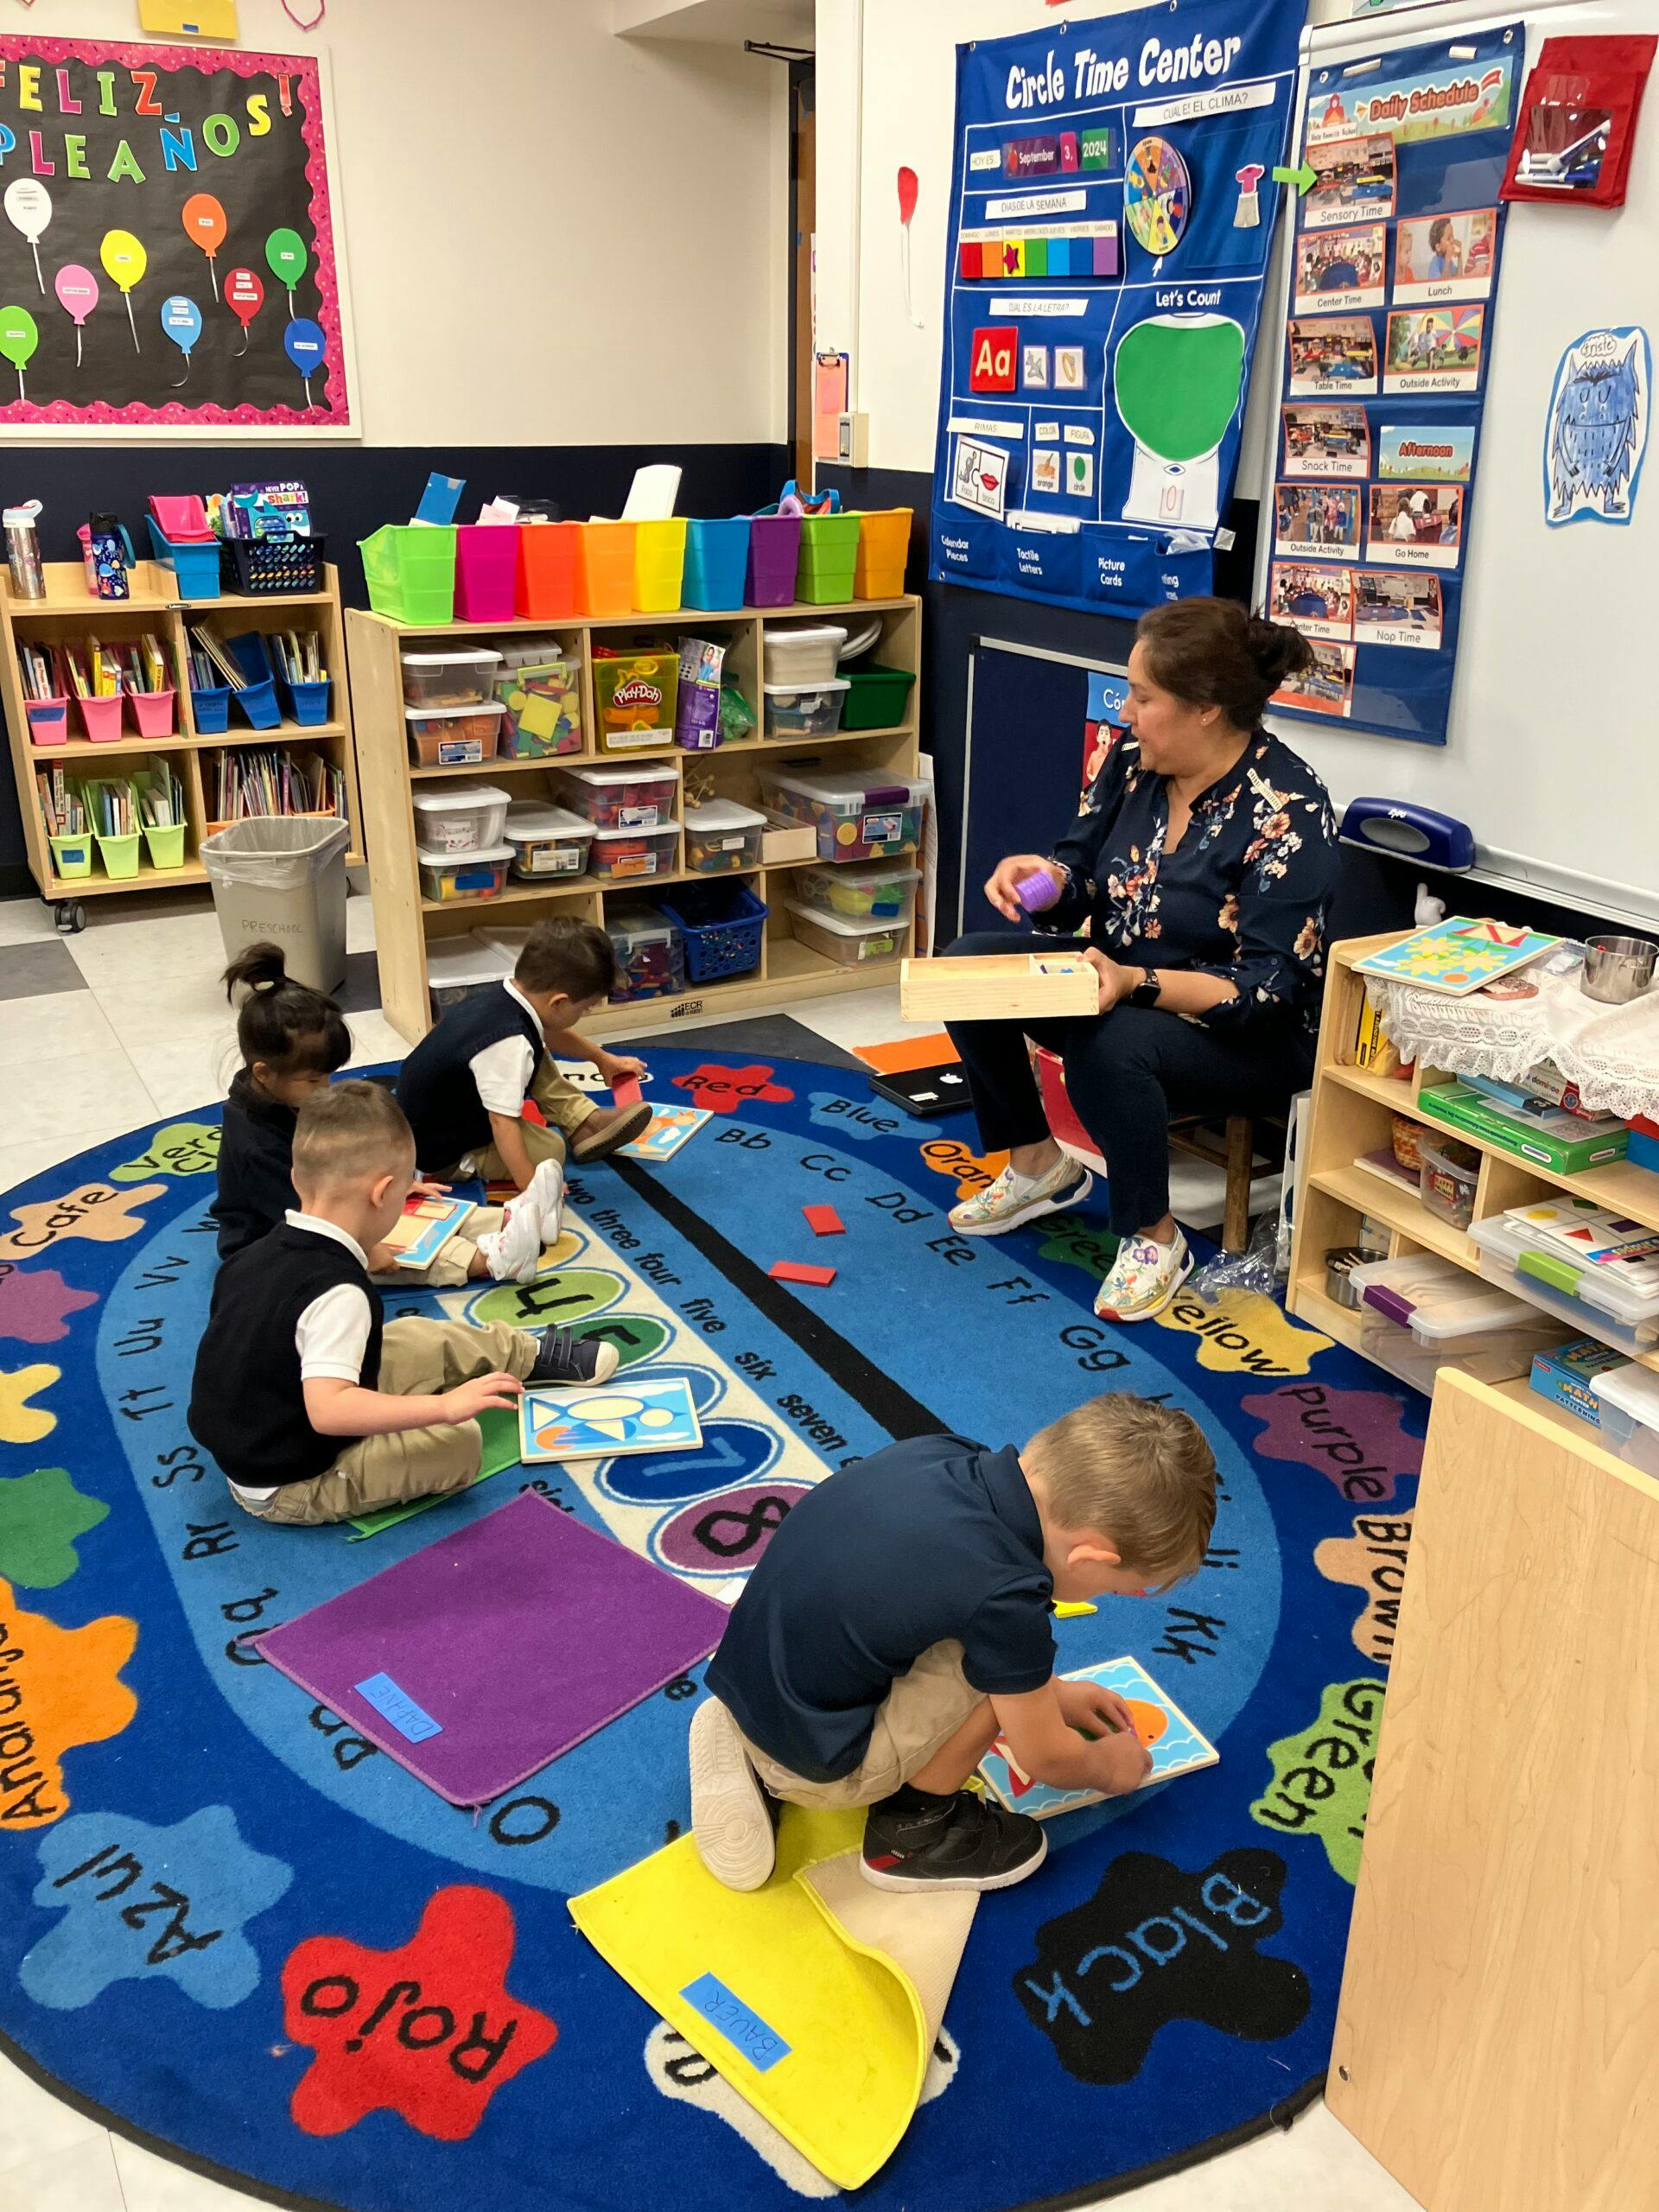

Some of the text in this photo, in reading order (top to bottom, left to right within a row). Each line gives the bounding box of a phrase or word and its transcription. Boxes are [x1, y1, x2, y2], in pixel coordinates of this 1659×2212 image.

[1006, 34, 1242, 110] Circle Time Center
[1193, 100, 1205, 112] EL
[1208, 92, 1249, 110] CLIMA?
[1370, 80, 1479, 122] Daily Schedule
[1019, 140, 1107, 165] September 3, 2024
[1036, 197, 1067, 211] SEMANA
[1320, 205, 1383, 225] Sensory Time
[1155, 289, 1222, 307] Let's Count
[1317, 294, 1362, 308] Center Time
[1427, 285, 1452, 297] Lunch
[975, 339, 1011, 378] Aa
[1314, 379, 1352, 391] Table Time
[1400, 376, 1460, 390] Outside Activity
[975, 423, 997, 433] RIMAS
[1039, 427, 1056, 435] COLOR
[1398, 442, 1452, 459] Afternoon
[1301, 460, 1352, 473] Snack Time
[279, 482, 300, 492] POP
[1037, 479, 1054, 490] orange
[268, 492, 307, 505] shark!
[941, 534, 969, 550] Calendar
[1290, 542, 1344, 557] Outside Activity
[946, 548, 969, 563] Pieces
[1017, 548, 1039, 562] Tactile
[1395, 548, 1429, 560] Go Home
[1019, 562, 1043, 575] Letters
[1098, 557, 1126, 572] Picture
[1100, 573, 1123, 588] Cards
[1313, 622, 1331, 634] Time
[1376, 630, 1421, 645] Nap Time
[614, 685, 659, 704] Play-Doh
[242, 918, 305, 935] PRESCHOOL
[682, 1076, 767, 1096] Red
[820, 1099, 899, 1134] Blue
[714, 1128, 772, 1150] Bb
[800, 1154, 851, 1182] Cc
[865, 1191, 933, 1224] Dd
[10, 1191, 119, 1248] Cafe
[925, 1236, 978, 1267] Ee
[135, 1255, 190, 1291] Vv
[987, 1276, 1051, 1306] Ff
[113, 1316, 165, 1357] Uu
[589, 1209, 641, 1250] three
[633, 1252, 683, 1287] four
[679, 1297, 728, 1334] five
[734, 1351, 778, 1382] six
[777, 1392, 848, 1452] seven
[1058, 1324, 1132, 1371] Gg
[1555, 1394, 1601, 1424] PATTERNING
[641, 1436, 747, 1478] 7
[151, 1444, 207, 1493] Ss
[1152, 1606, 1227, 1665] Kk
[370, 1682, 435, 1738] DAPHNE
[53, 1843, 225, 1965] Azul
[1024, 1872, 1272, 2027] Black
[299, 1974, 518, 2085] Rojo
[702, 1986, 777, 2065] BAUER
